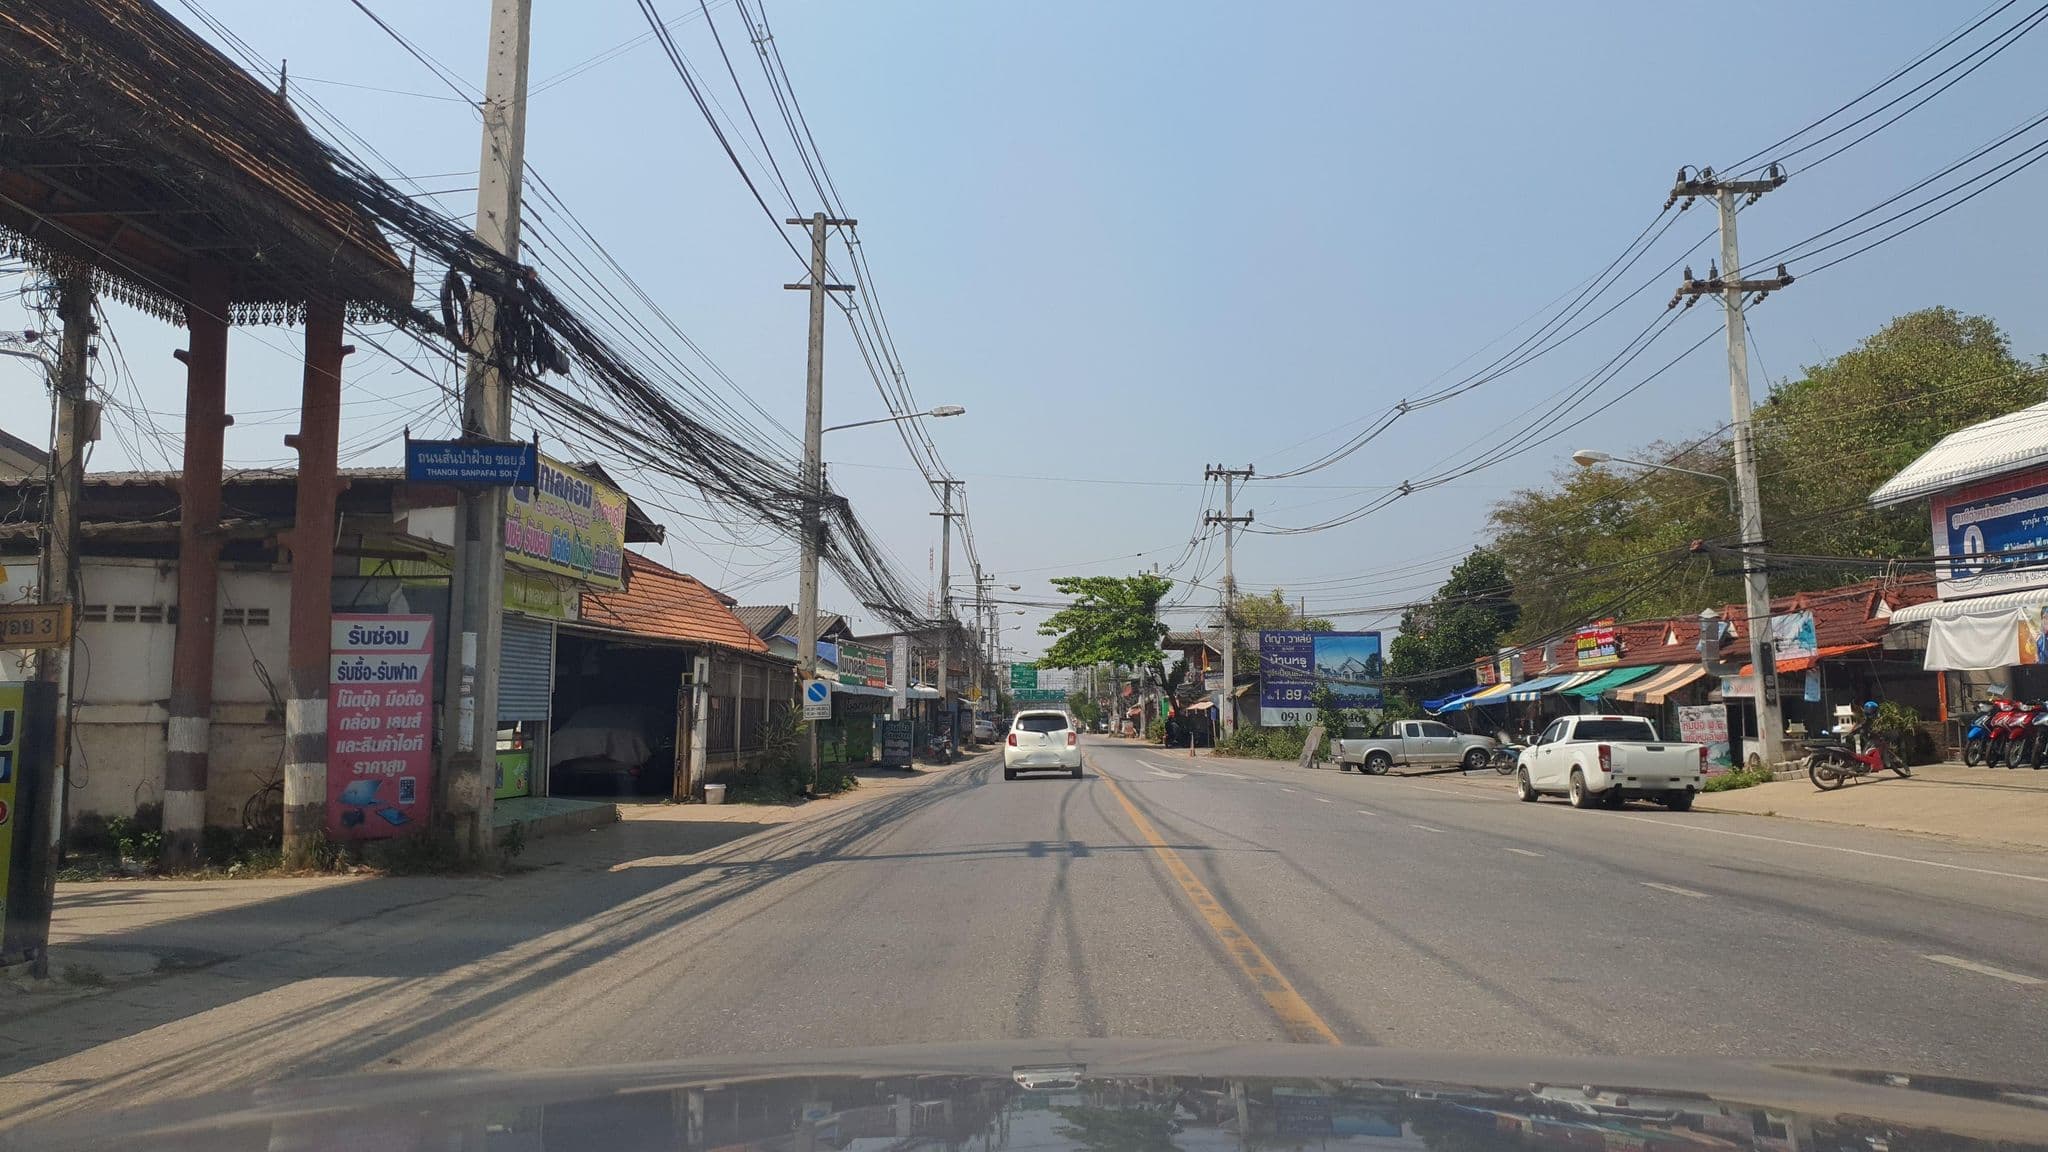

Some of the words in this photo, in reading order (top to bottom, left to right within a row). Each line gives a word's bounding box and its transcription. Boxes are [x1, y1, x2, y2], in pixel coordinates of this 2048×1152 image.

[495, 455, 517, 465] ซอย
[519, 455, 526, 466] 3
[426, 468, 458, 476] THANON
[461, 468, 497, 477] SANPAFAI
[41, 618, 52, 634] 3
[348, 624, 409, 646] รับซ่อม
[337, 656, 418, 681] รับซื้อ-รับฝาก
[386, 689, 424, 707] มือถือ
[1274, 689, 1302, 700] 1.89
[339, 712, 381, 730] กล้อง
[386, 711, 422, 729] เลนส์
[1281, 711, 1300, 722] 091
[336, 733, 424, 754] และสินค้าไอที
[352, 759, 406, 777] ราคาสูง
